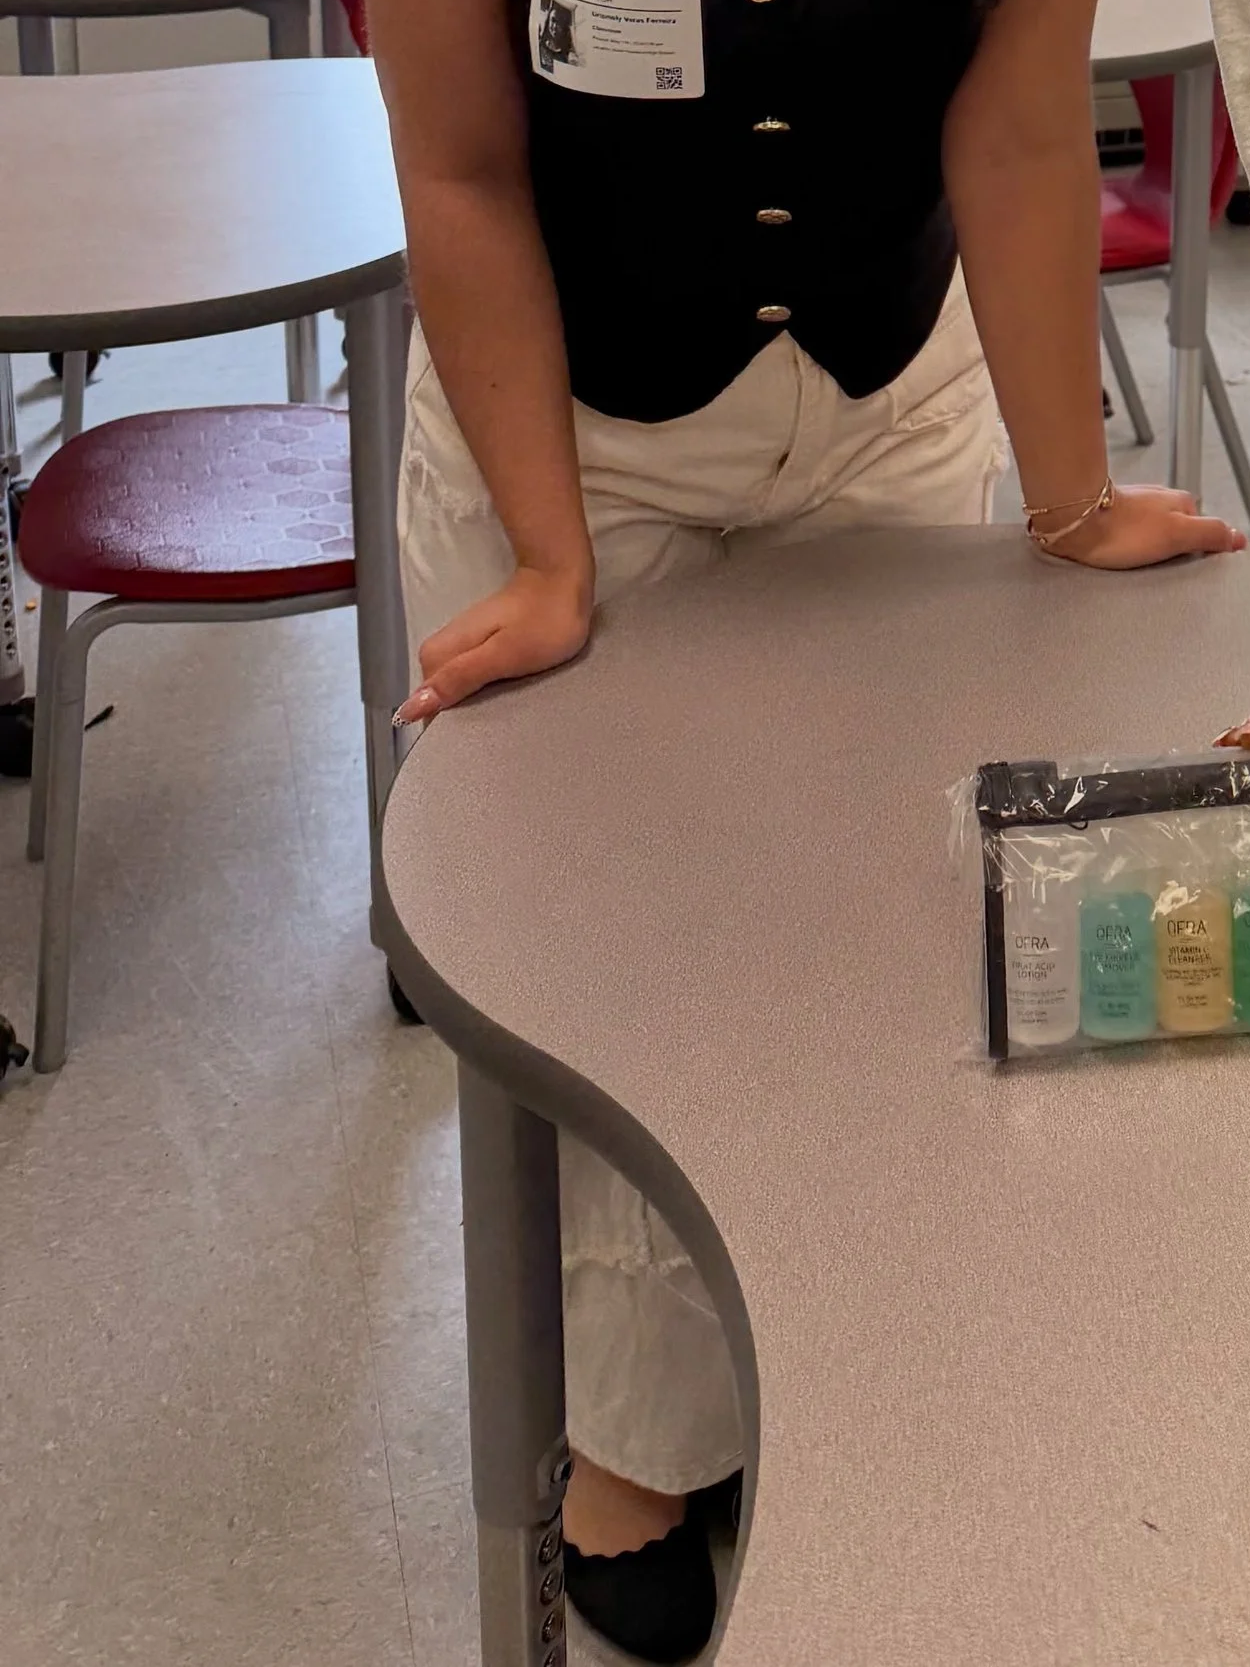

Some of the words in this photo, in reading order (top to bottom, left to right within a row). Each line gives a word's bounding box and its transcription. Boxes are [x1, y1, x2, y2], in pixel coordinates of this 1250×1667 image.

[1096, 924, 1132, 941] OFRA
[1167, 919, 1208, 937] OFRA
[1015, 936, 1050, 950] OFRA
